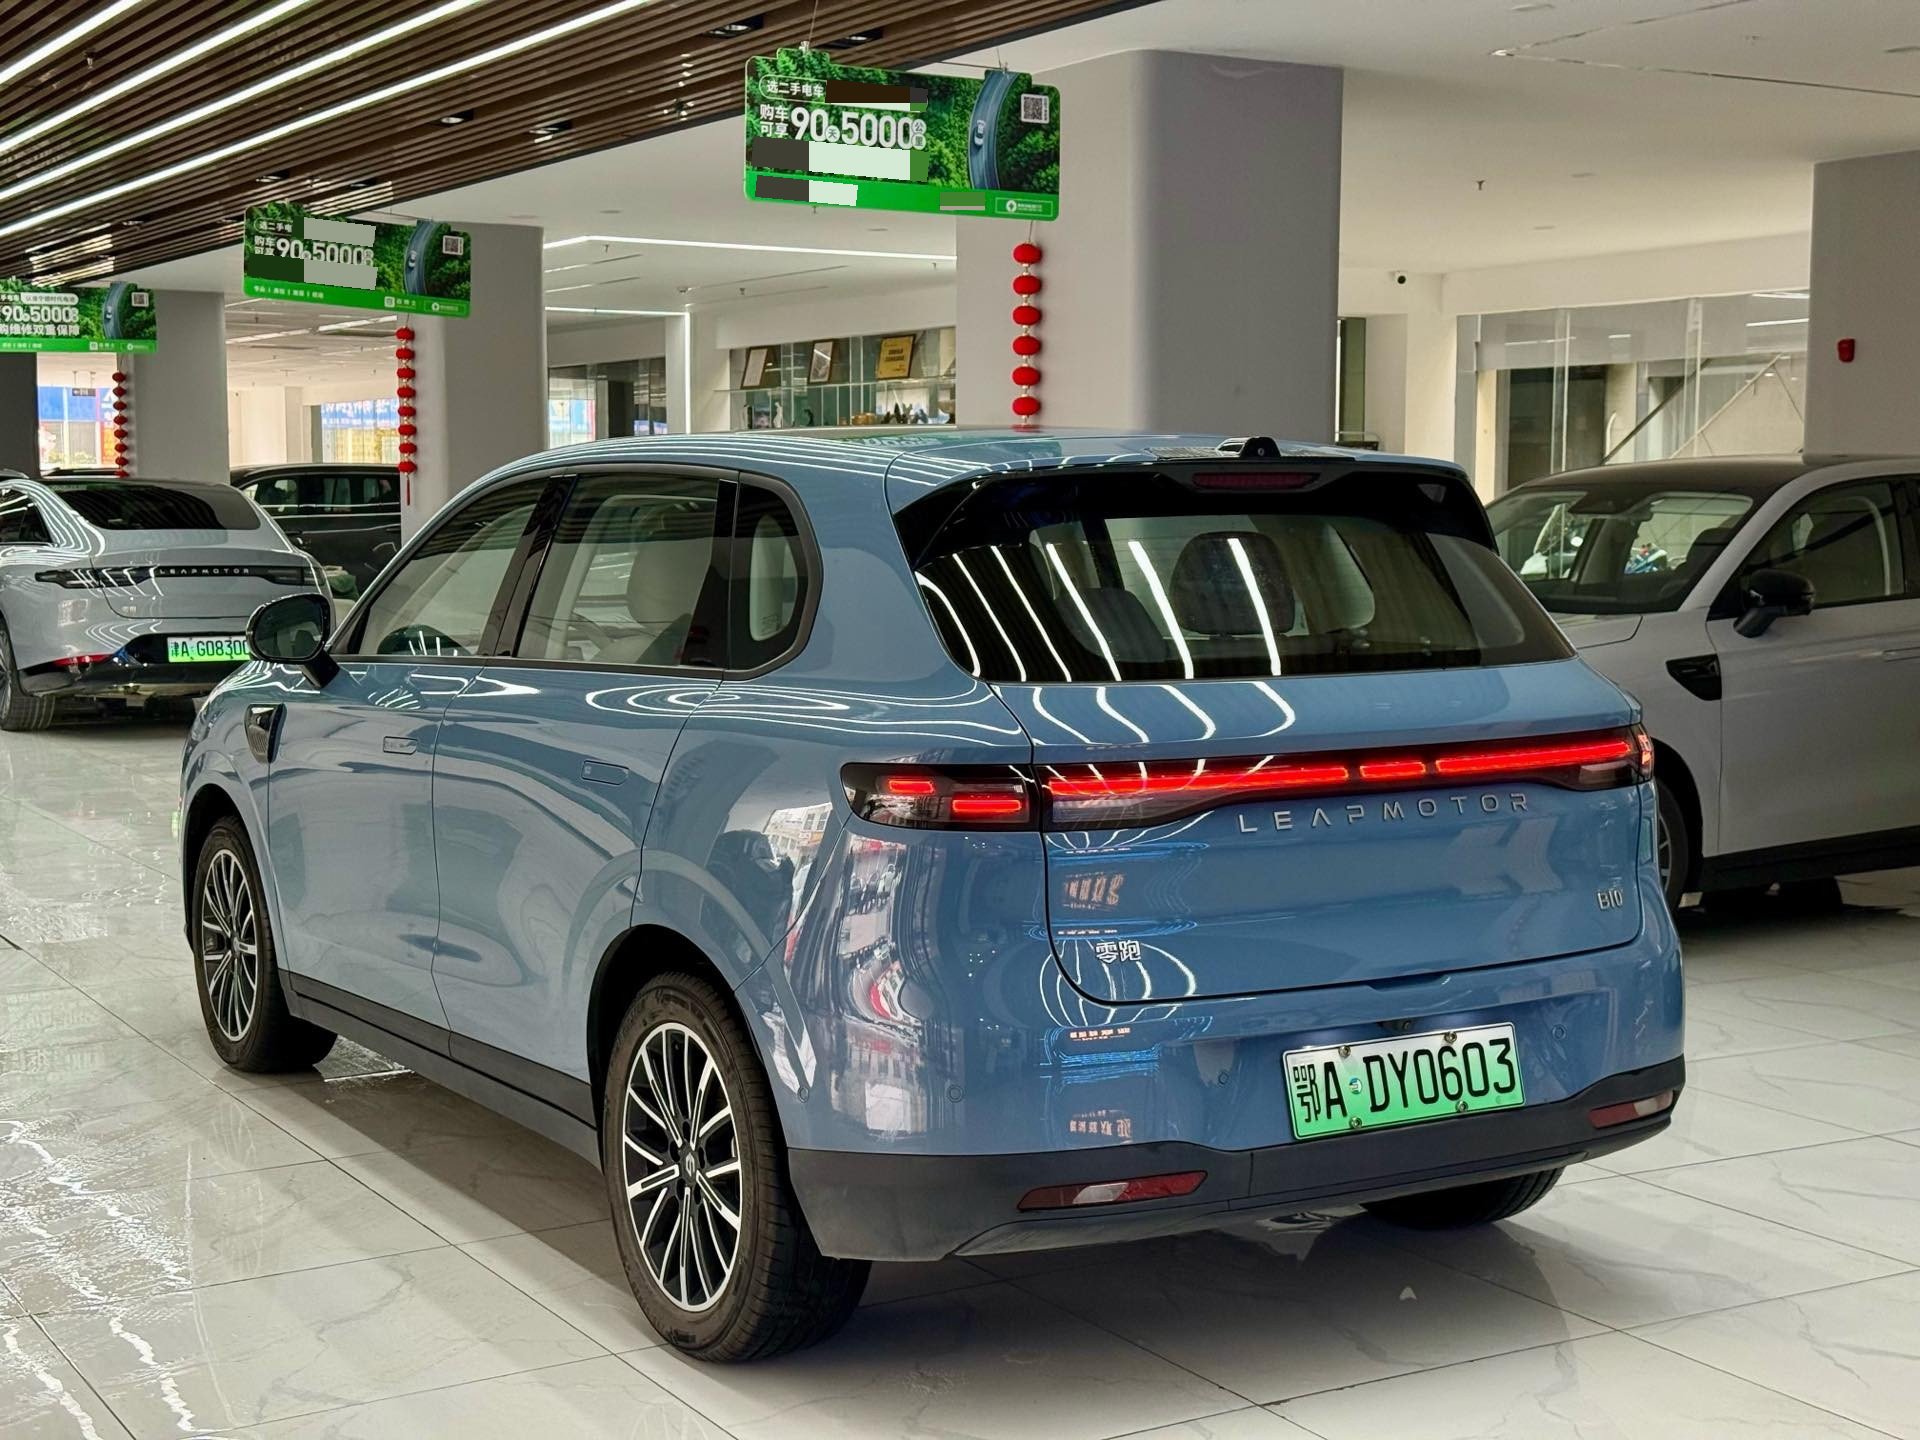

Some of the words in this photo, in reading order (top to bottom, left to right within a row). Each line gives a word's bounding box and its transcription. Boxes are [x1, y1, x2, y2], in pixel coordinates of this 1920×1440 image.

[767, 80, 825, 98] 选二手电车
[159, 567, 250, 575] LEAPMOTOR
[1237, 793, 1529, 833] LEAPMOTOR
[1597, 890, 1623, 910] B10
[1096, 940, 1141, 963] 零跑
